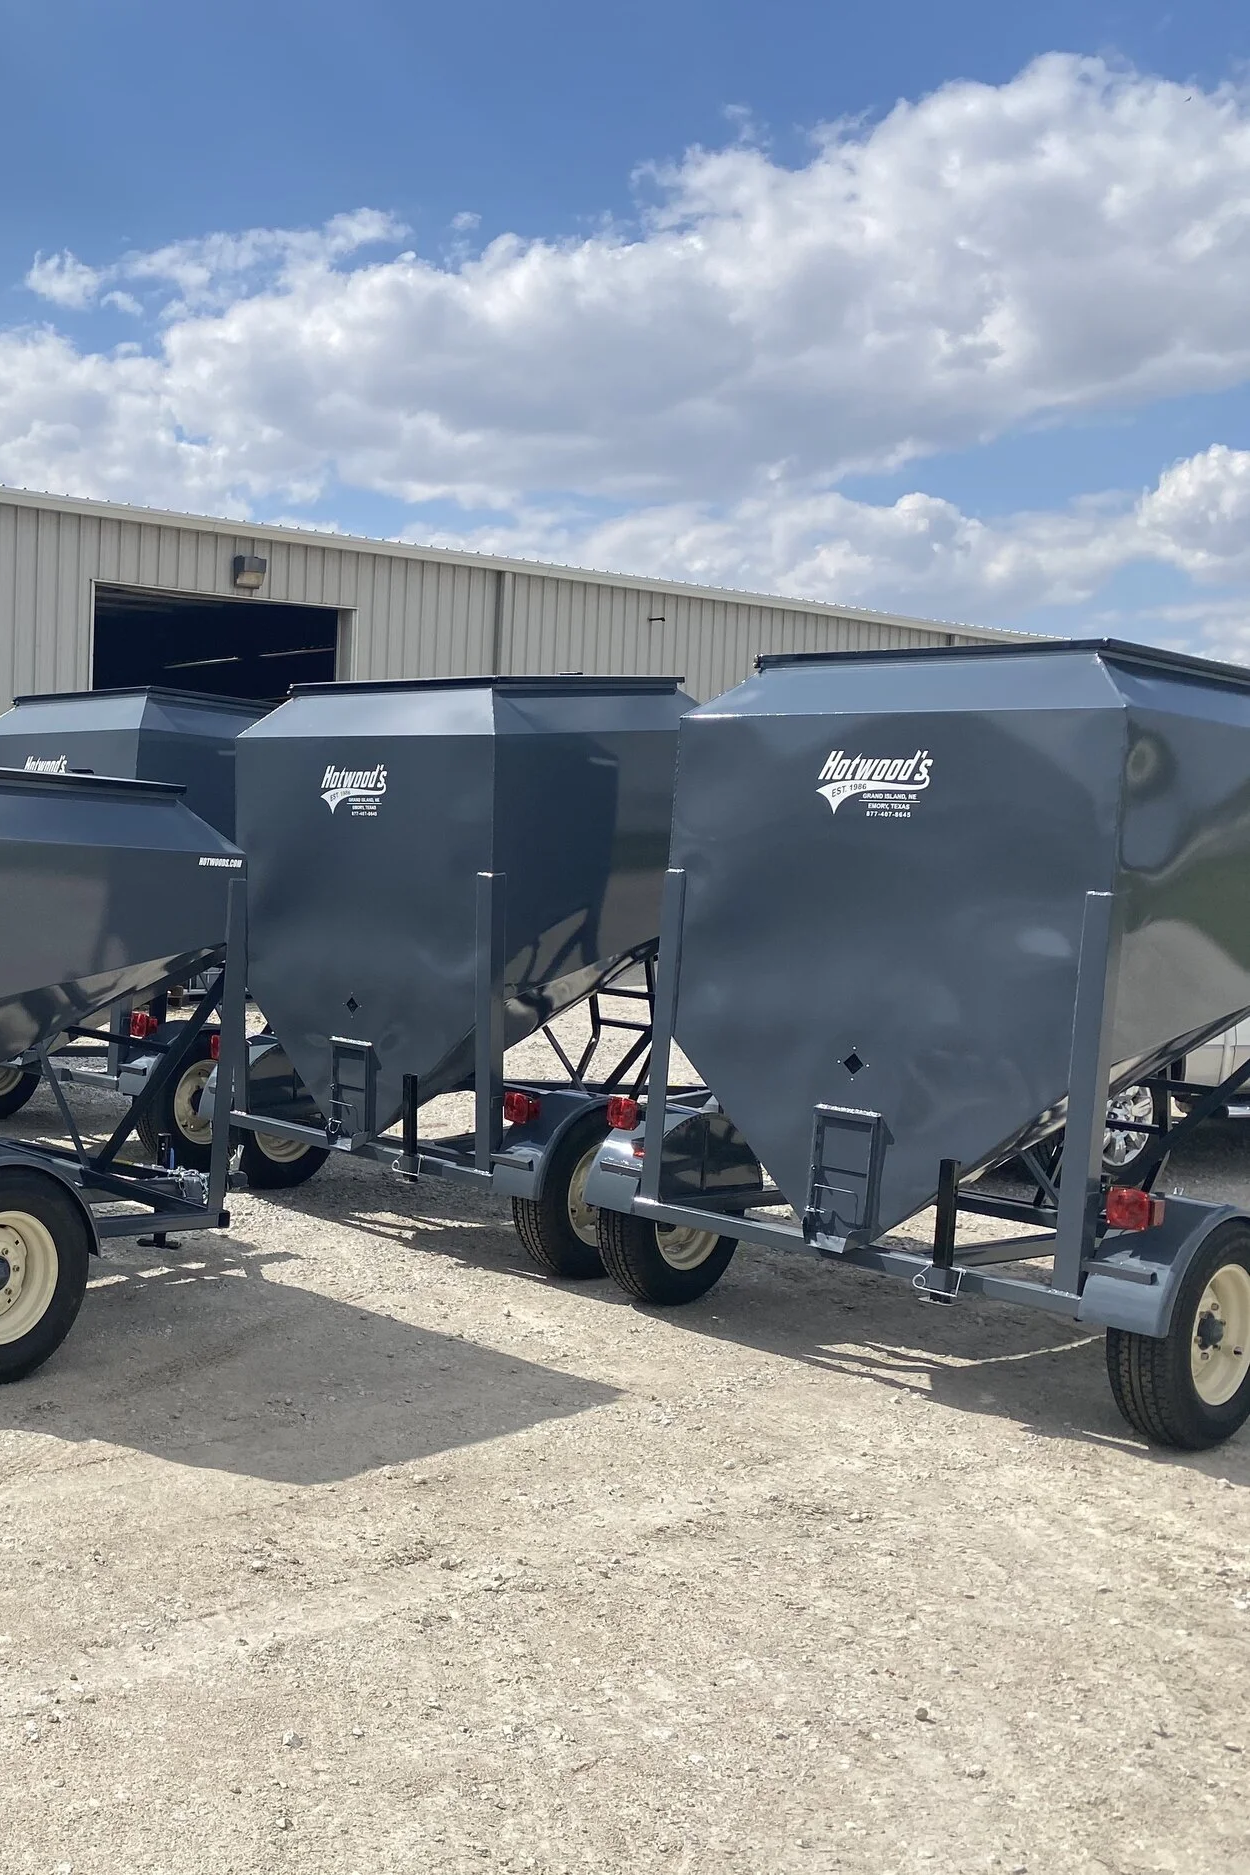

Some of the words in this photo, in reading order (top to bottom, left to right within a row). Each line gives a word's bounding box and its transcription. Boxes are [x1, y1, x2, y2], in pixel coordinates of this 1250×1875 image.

[320, 763, 388, 788] Hotwood's
[817, 749, 933, 781] Hotwood's
[831, 785, 848, 798] EST.
[849, 783, 867, 792] 1986
